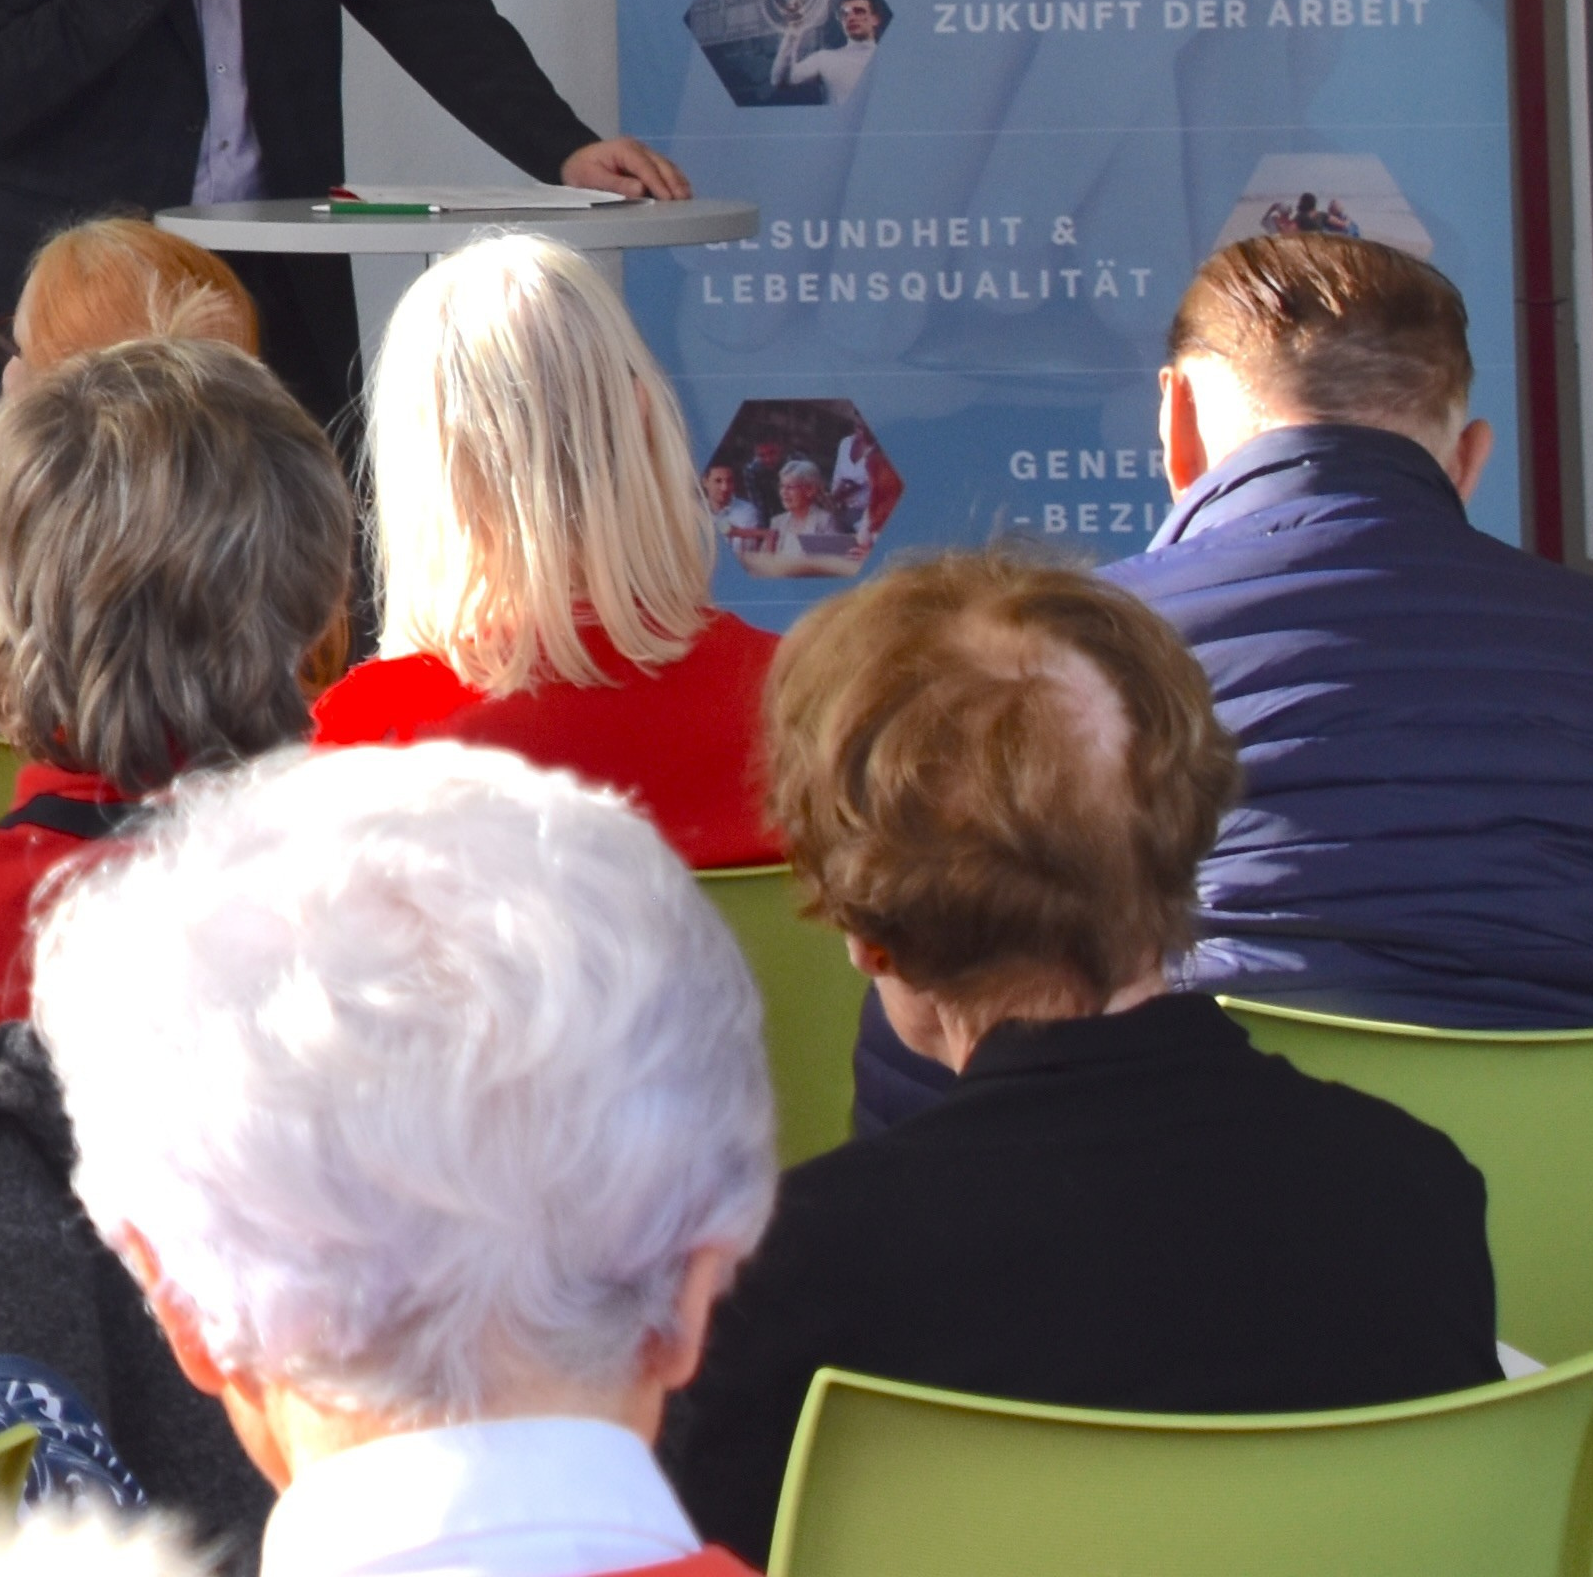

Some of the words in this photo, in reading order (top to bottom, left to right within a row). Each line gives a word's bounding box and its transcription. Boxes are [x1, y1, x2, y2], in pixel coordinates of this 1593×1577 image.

[934, 1, 1141, 33] ZUKUNFT
[1164, 0, 1246, 29] DER
[705, 217, 1022, 251] SUNDHEIT
[1051, 216, 1079, 245] &
[703, 261, 1152, 304] LEBENSQUALITÄT
[1013, 503, 1175, 533] -BEZI
